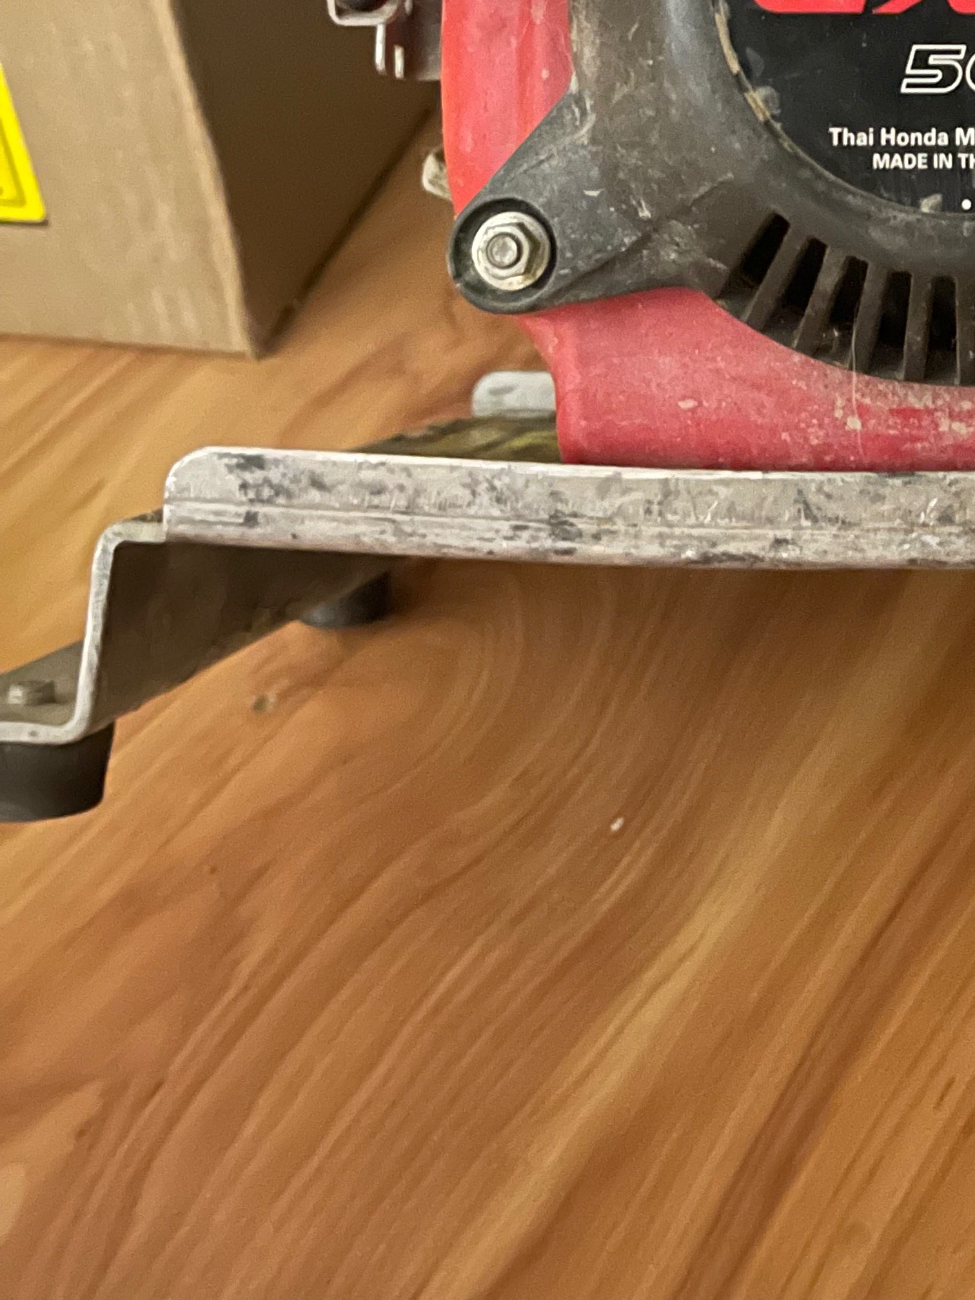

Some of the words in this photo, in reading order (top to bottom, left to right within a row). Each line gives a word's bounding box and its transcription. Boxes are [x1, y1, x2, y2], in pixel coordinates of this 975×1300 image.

[828, 128, 874, 146] Thai
[881, 128, 949, 146] Honda
[873, 153, 928, 170] MADE
[933, 153, 953, 170] IN
